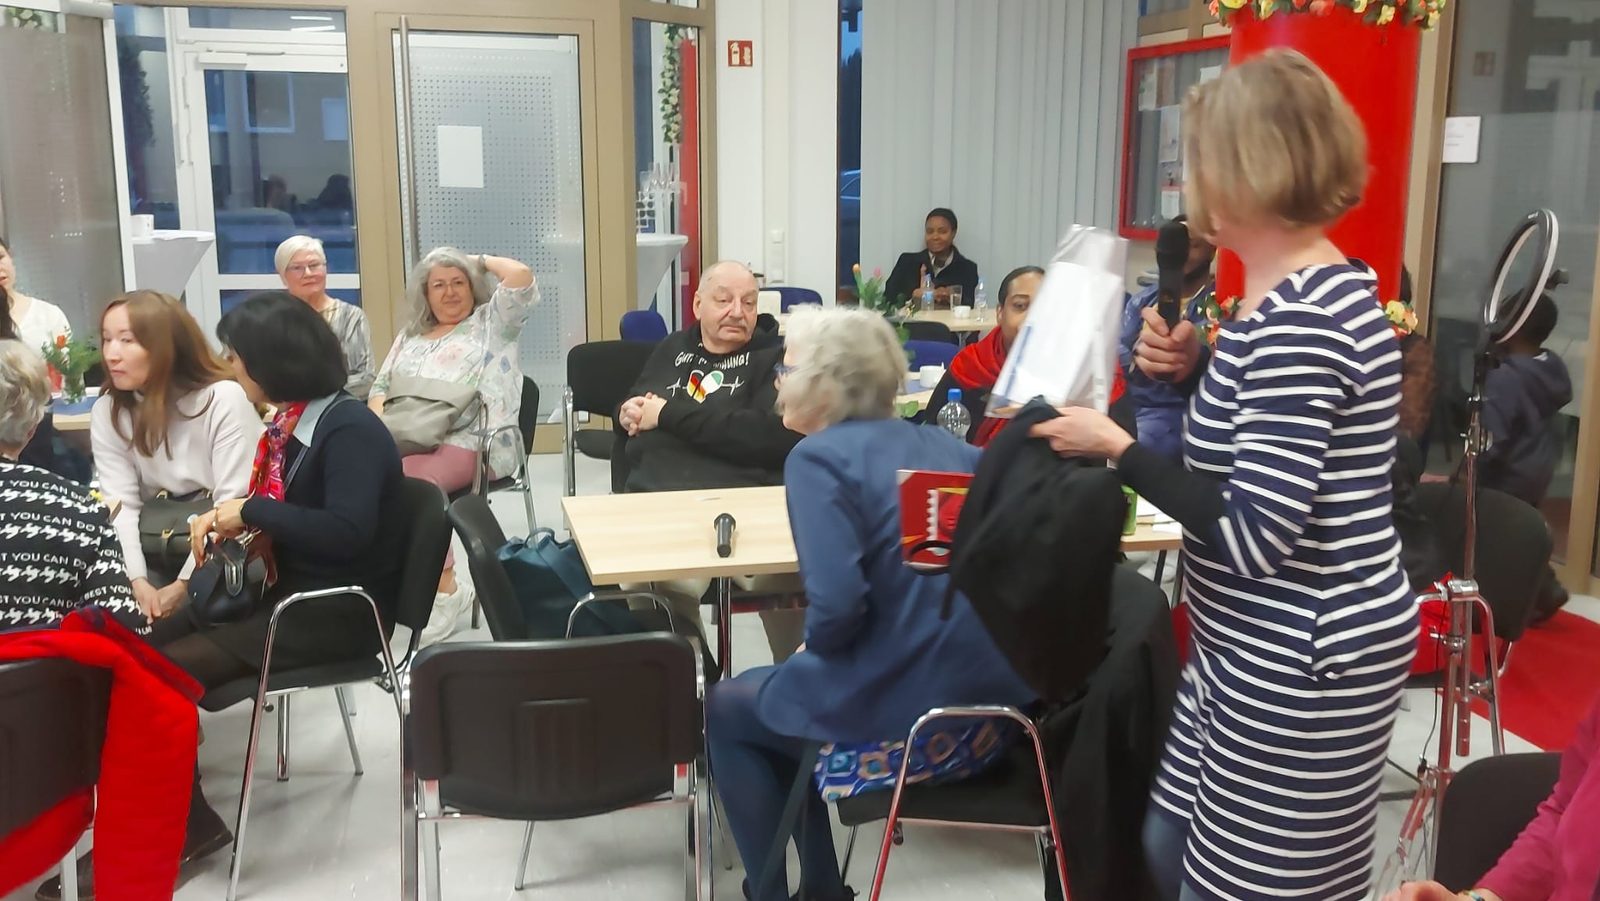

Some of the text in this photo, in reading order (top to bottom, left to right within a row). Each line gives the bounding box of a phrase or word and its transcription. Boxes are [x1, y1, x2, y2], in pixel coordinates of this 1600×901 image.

[10, 480, 40, 489] YOU
[42, 482, 68, 495] CAN
[11, 511, 40, 521] YOU
[43, 515, 72, 526] CAN
[77, 520, 95, 532] DO
[12, 552, 40, 561] YOU
[43, 553, 68, 565] CAN
[73, 557, 87, 570] DO
[110, 584, 132, 595] YOU
[13, 595, 41, 604] YOU
